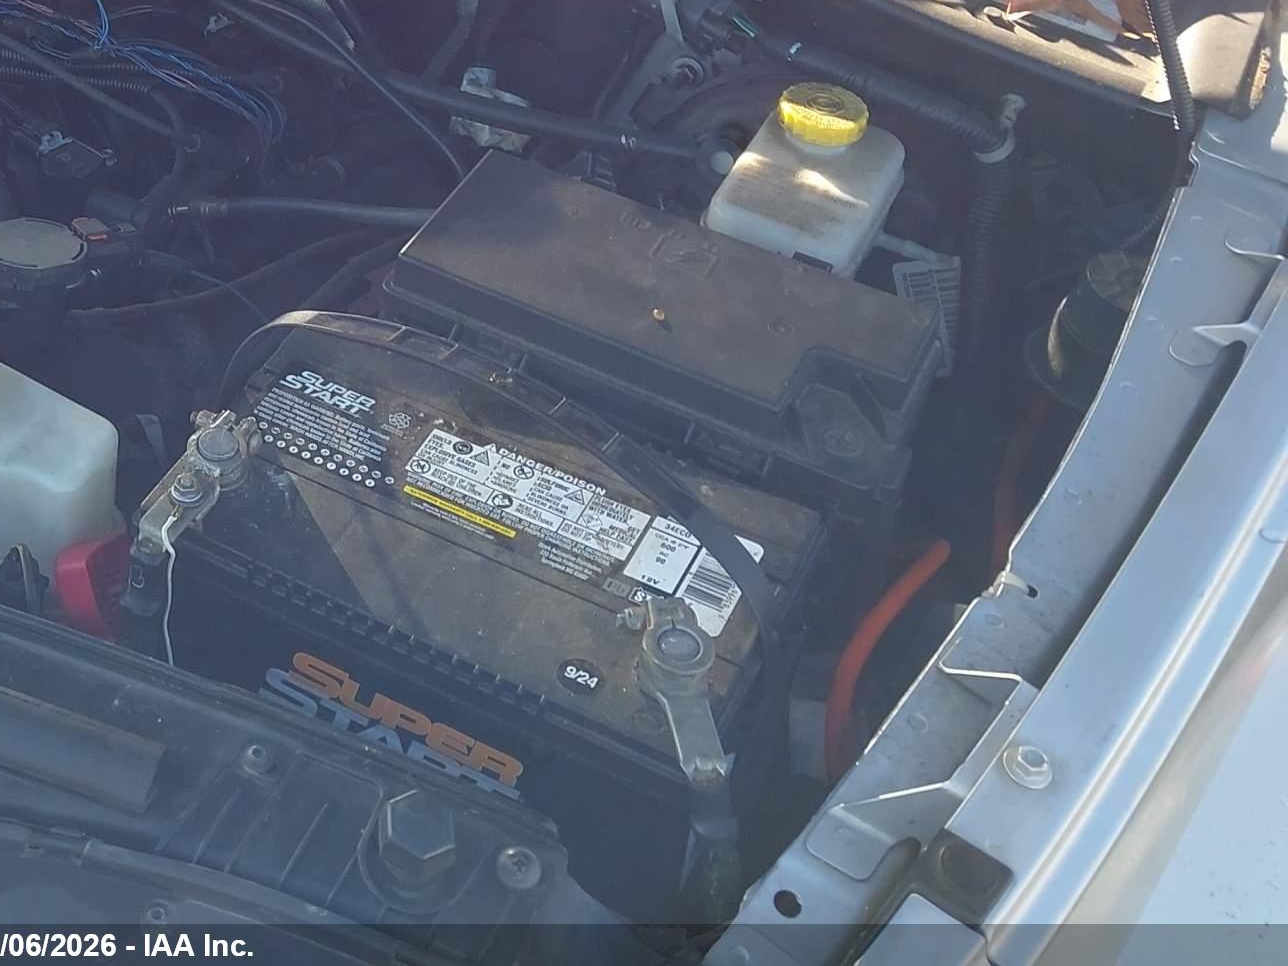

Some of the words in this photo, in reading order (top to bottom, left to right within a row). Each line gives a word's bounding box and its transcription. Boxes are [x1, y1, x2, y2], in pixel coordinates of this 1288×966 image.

[279, 374, 370, 414] START
[302, 370, 376, 408] SUPER
[498, 447, 607, 496] DANGER/POISON
[661, 543, 676, 552] 600
[641, 575, 660, 585] 12V
[564, 665, 598, 689] 9/24
[289, 651, 524, 787] SUPER
